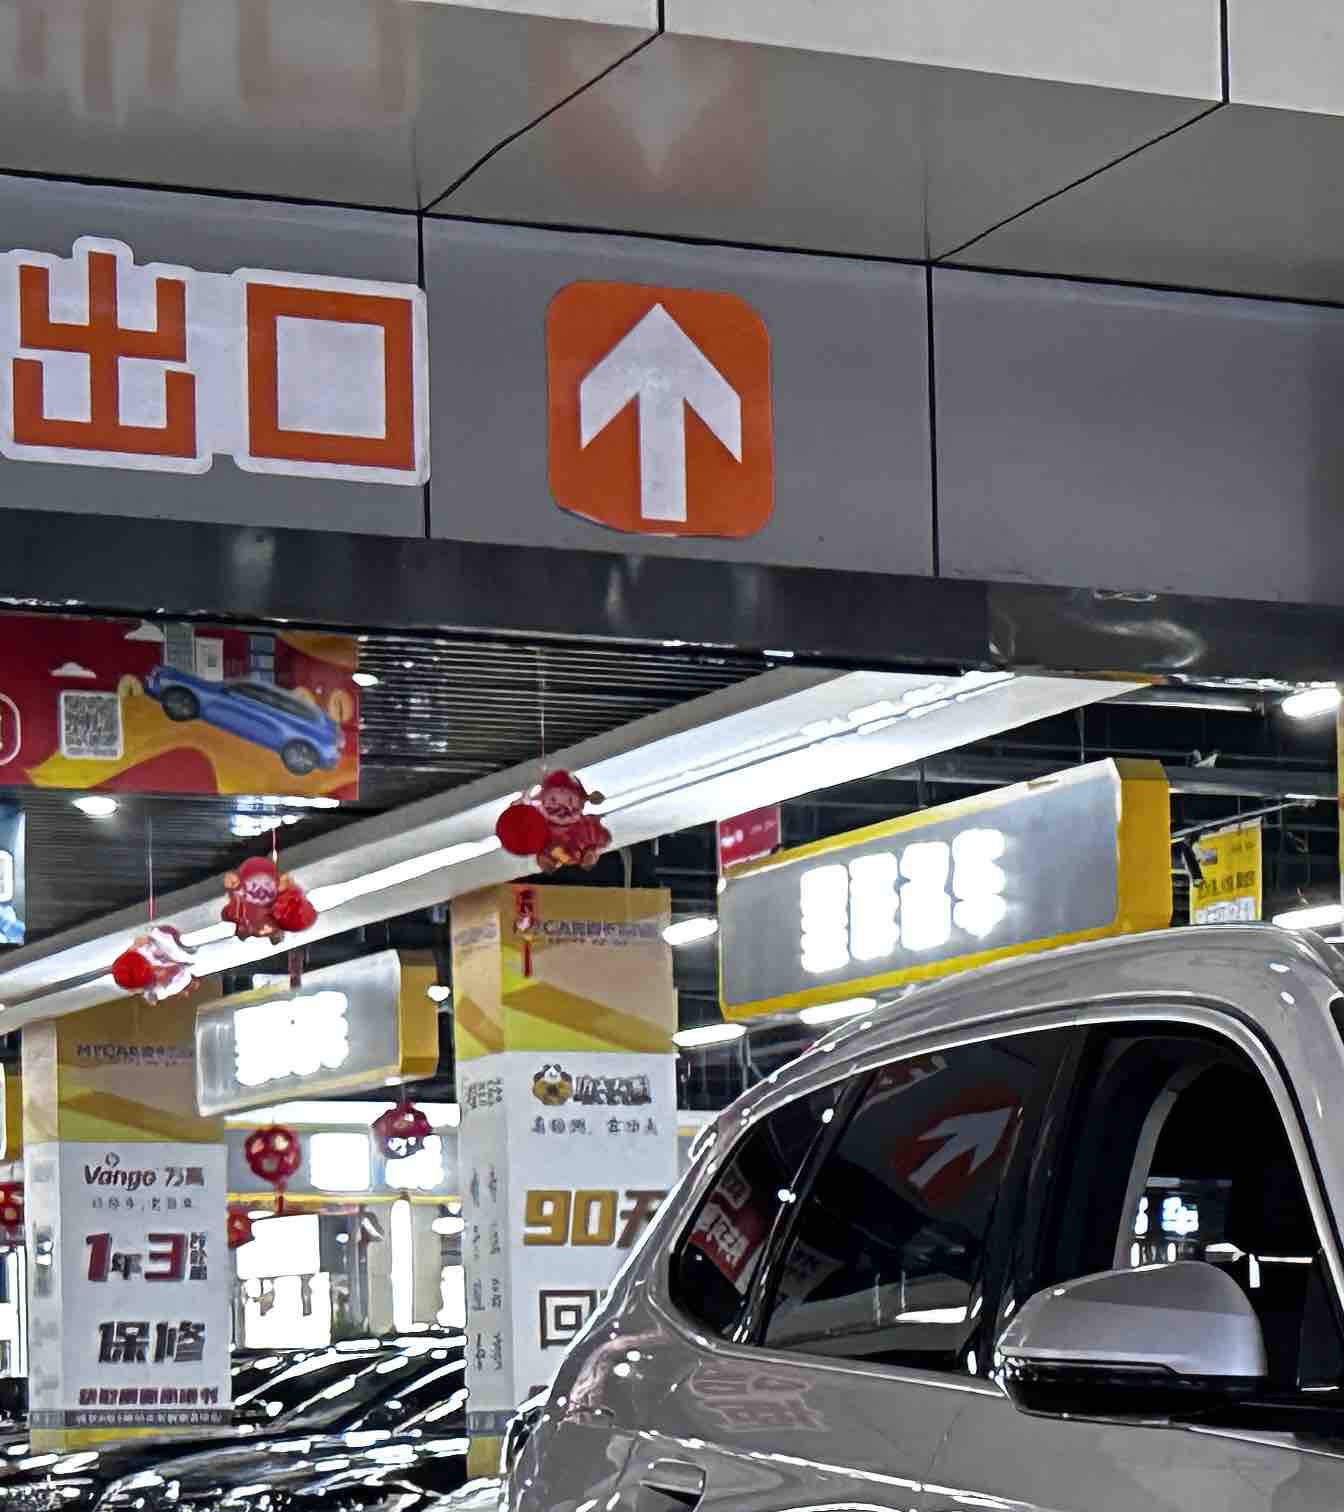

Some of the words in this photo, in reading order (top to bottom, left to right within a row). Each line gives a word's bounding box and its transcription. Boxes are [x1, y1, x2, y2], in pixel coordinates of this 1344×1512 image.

[12, 249, 417, 472] 出口
[84, 1165, 158, 1191] Vango
[523, 1189, 670, 1249] 90天
[98, 1320, 205, 1363] 保修
